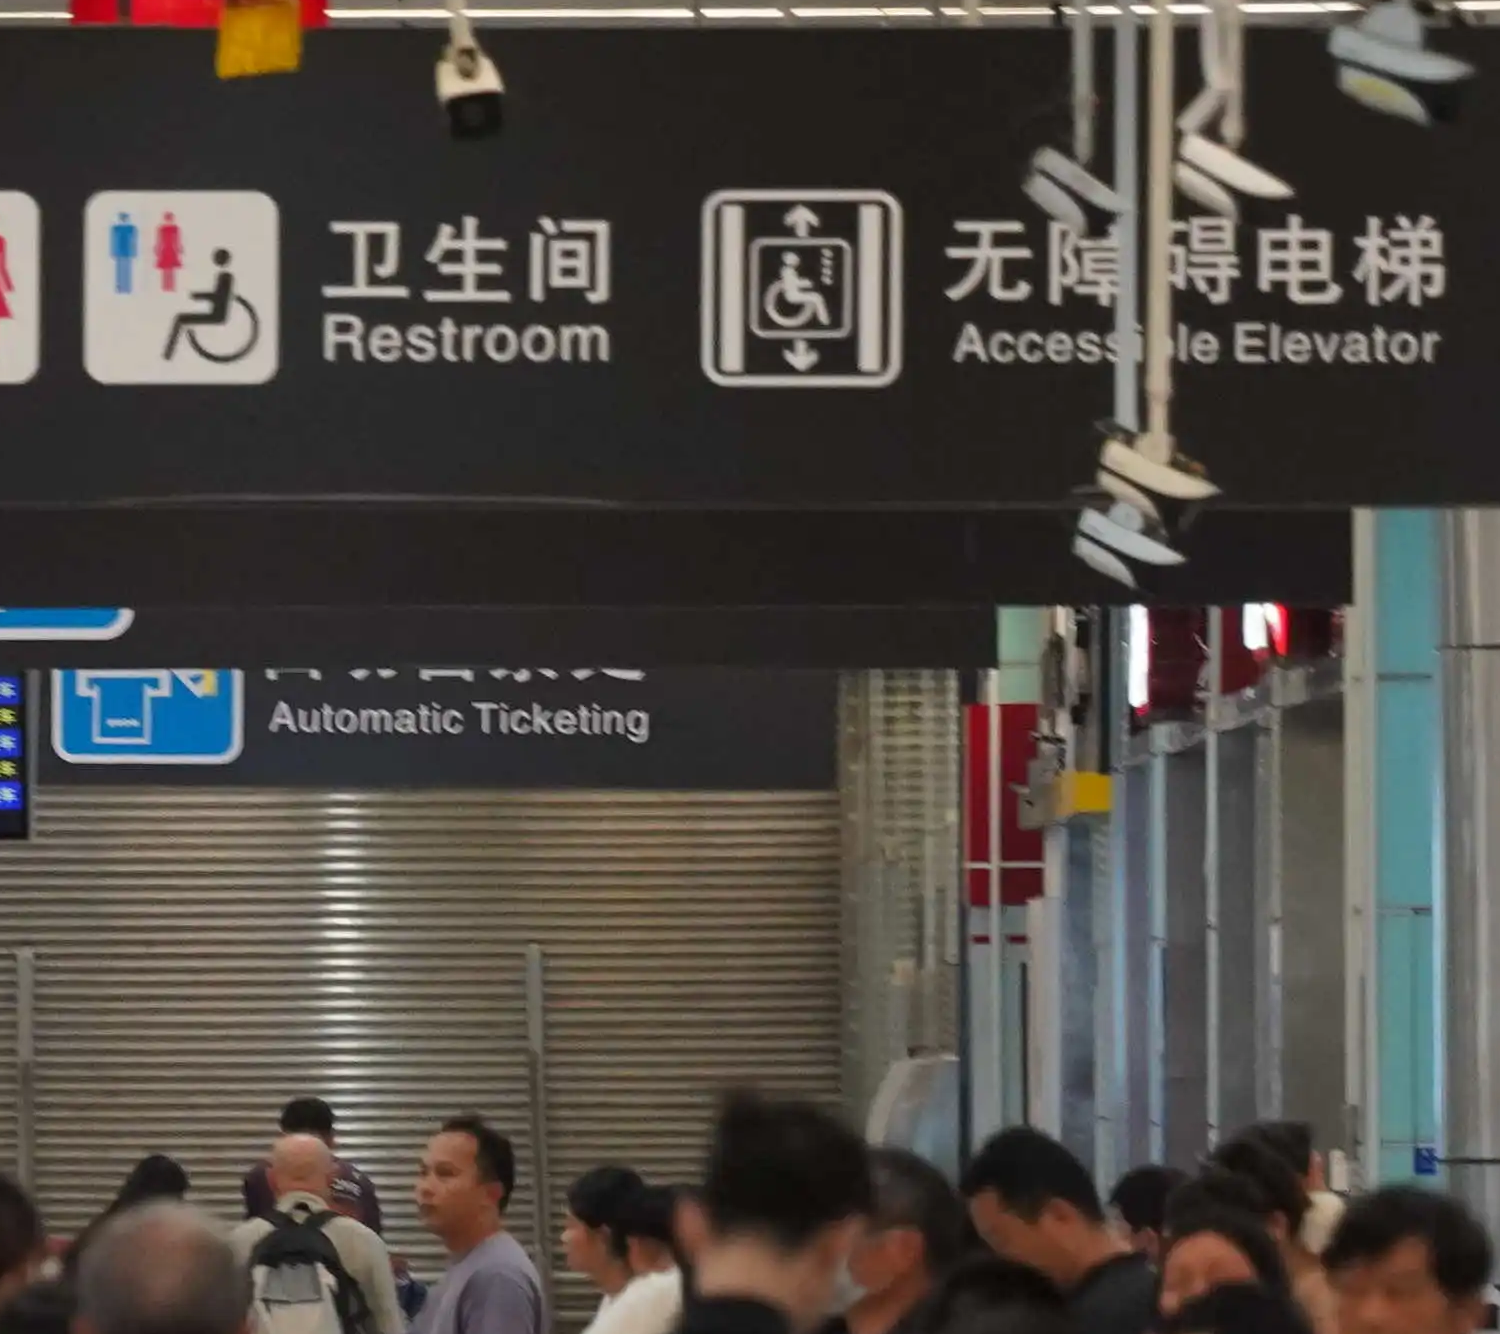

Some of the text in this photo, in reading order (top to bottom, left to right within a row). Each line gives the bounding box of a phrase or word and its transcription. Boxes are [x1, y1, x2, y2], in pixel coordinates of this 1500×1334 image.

[320, 215, 612, 305] 卫生间
[322, 313, 612, 364] Restroom
[952, 322, 1442, 364] Accessile Elevator
[267, 699, 650, 744] Automatic Ticketing
